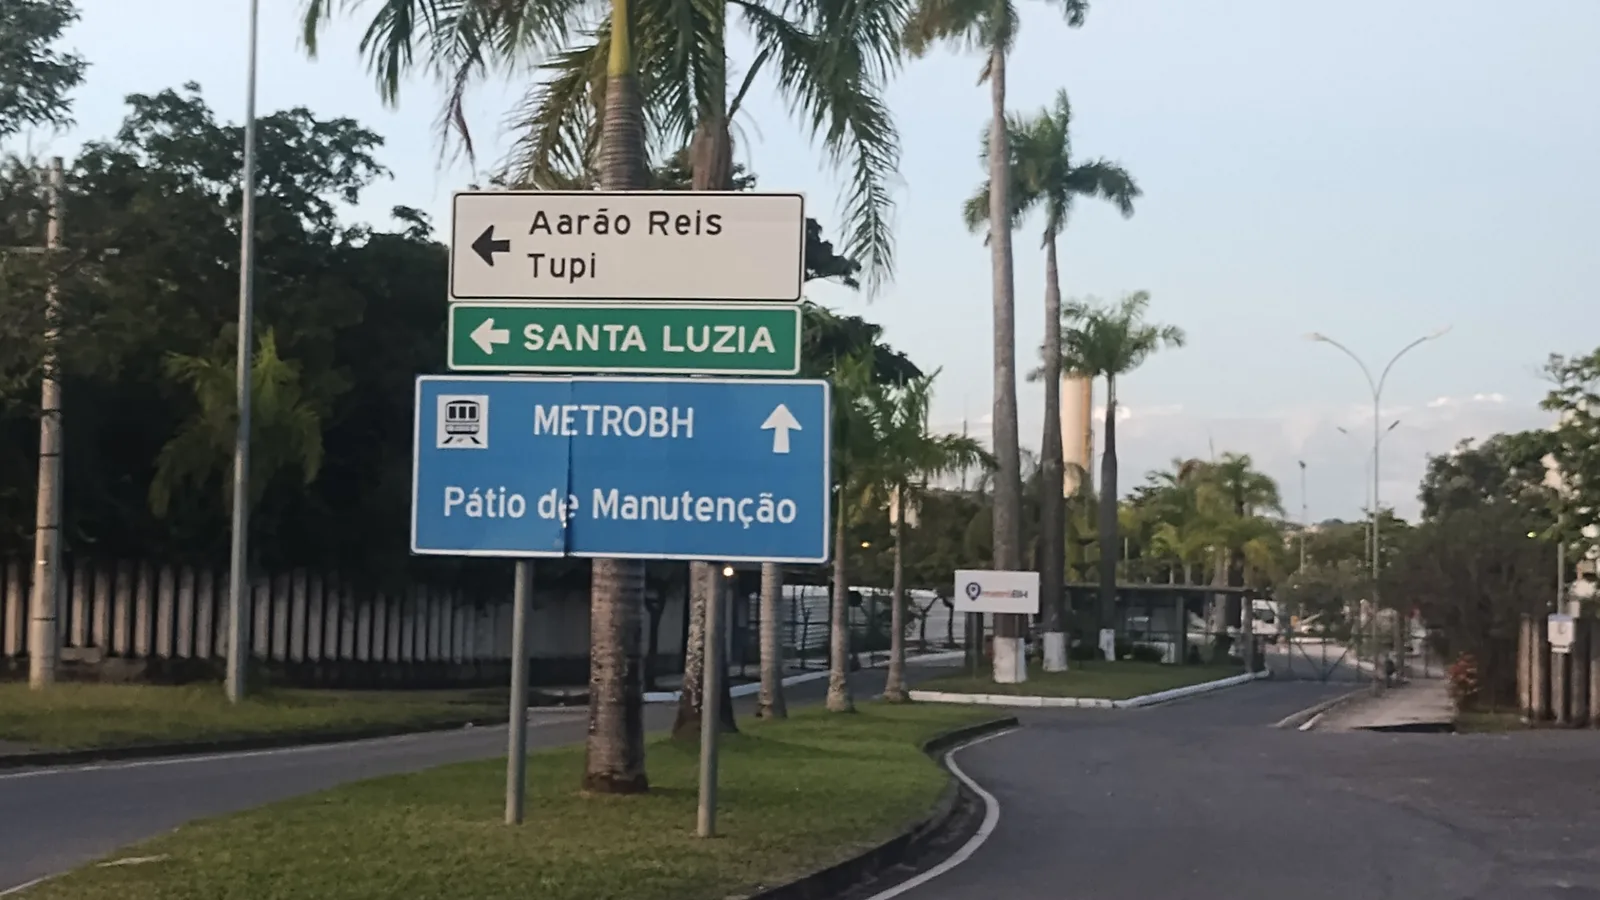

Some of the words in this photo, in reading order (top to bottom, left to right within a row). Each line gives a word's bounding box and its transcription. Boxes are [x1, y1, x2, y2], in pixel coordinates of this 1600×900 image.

[529, 208, 631, 236] Aarão
[648, 210, 723, 236] Reis
[527, 252, 596, 283] Tupi
[523, 324, 647, 352] SANTA
[663, 325, 776, 353] LUZIA
[533, 405, 694, 438] METROBH
[443, 486, 526, 518] Pátio
[537, 488, 579, 522] de
[592, 488, 797, 529] Manutenção
